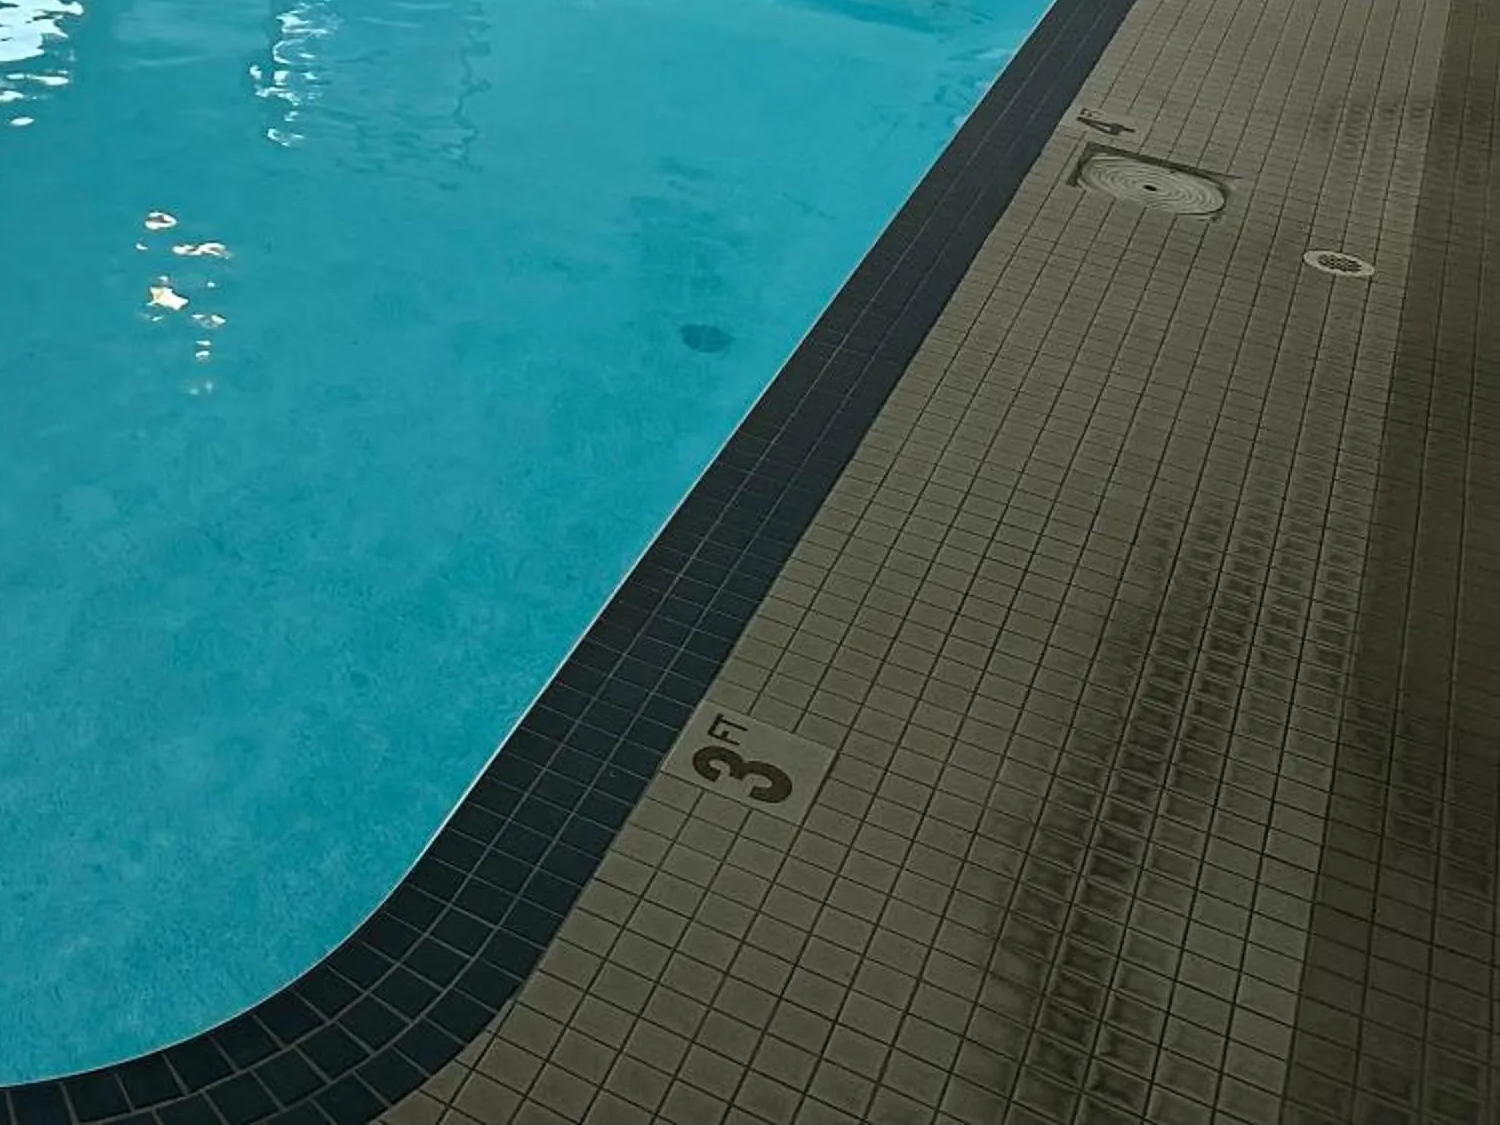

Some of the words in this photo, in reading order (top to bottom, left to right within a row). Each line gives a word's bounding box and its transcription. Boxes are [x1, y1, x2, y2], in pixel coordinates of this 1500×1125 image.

[1076, 116, 1136, 135] 4
[707, 713, 749, 746] FT
[692, 746, 792, 804] 3
